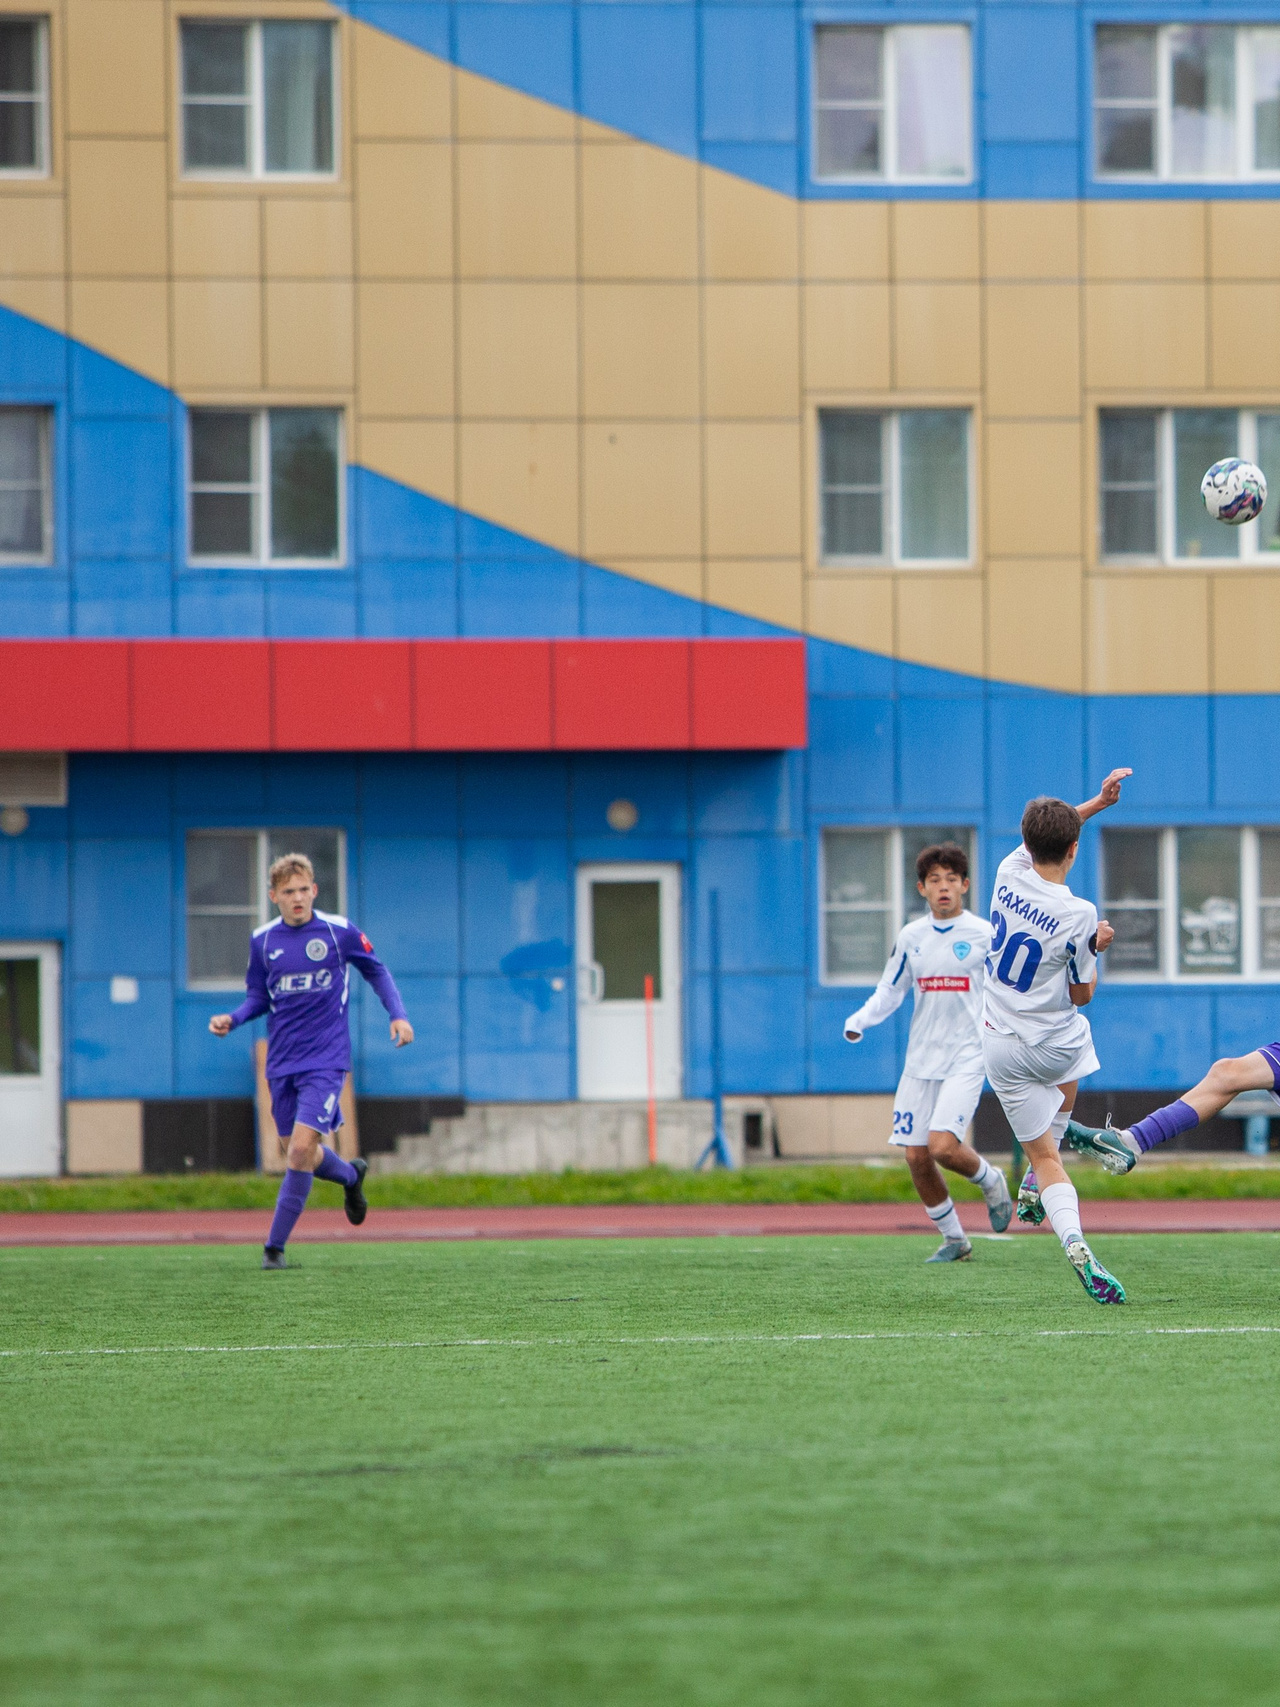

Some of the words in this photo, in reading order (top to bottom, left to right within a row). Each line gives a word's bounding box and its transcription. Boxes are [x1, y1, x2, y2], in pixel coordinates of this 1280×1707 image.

[997, 885, 1060, 936] САХАЛИН
[944, 977, 966, 988] Банк
[893, 1111, 914, 1135] 23
